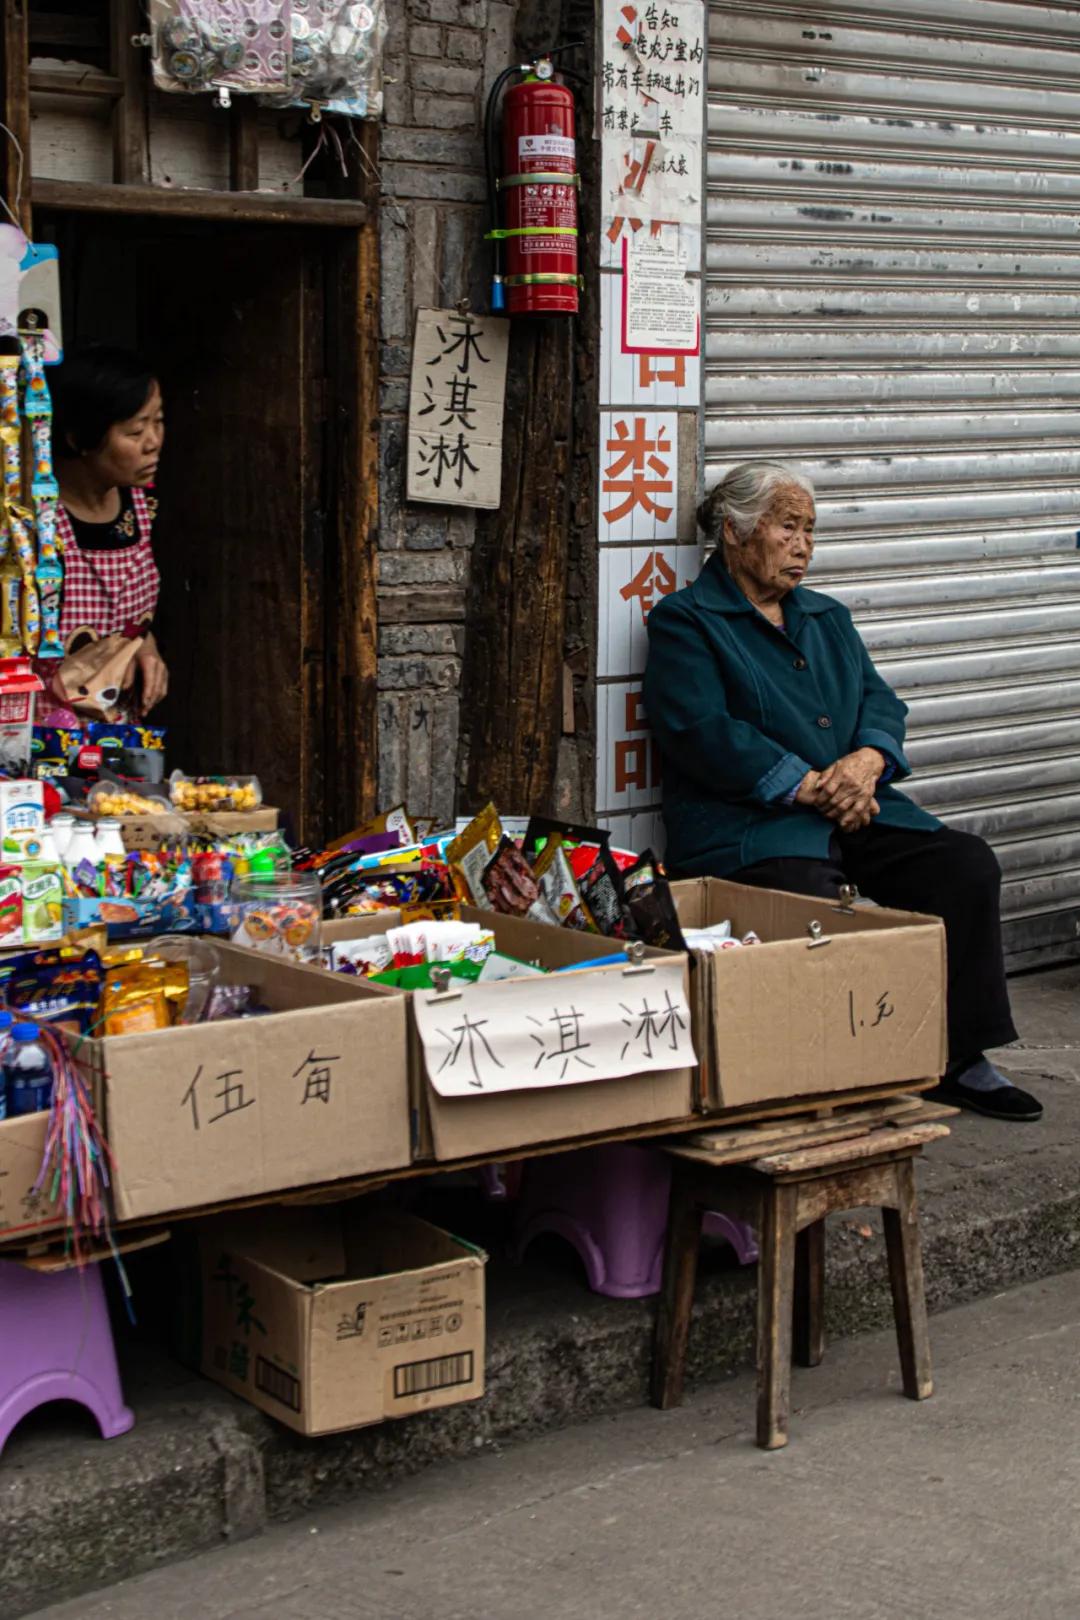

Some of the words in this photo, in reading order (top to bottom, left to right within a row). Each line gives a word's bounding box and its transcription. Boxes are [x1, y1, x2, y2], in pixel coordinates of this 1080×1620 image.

[645, 4, 678, 30] 告知
[602, 106, 673, 135] 前禁止车
[416, 323, 490, 489] 冰淇淋
[435, 989, 687, 1088] 冰淇淋
[181, 1049, 341, 1130] 伍角
